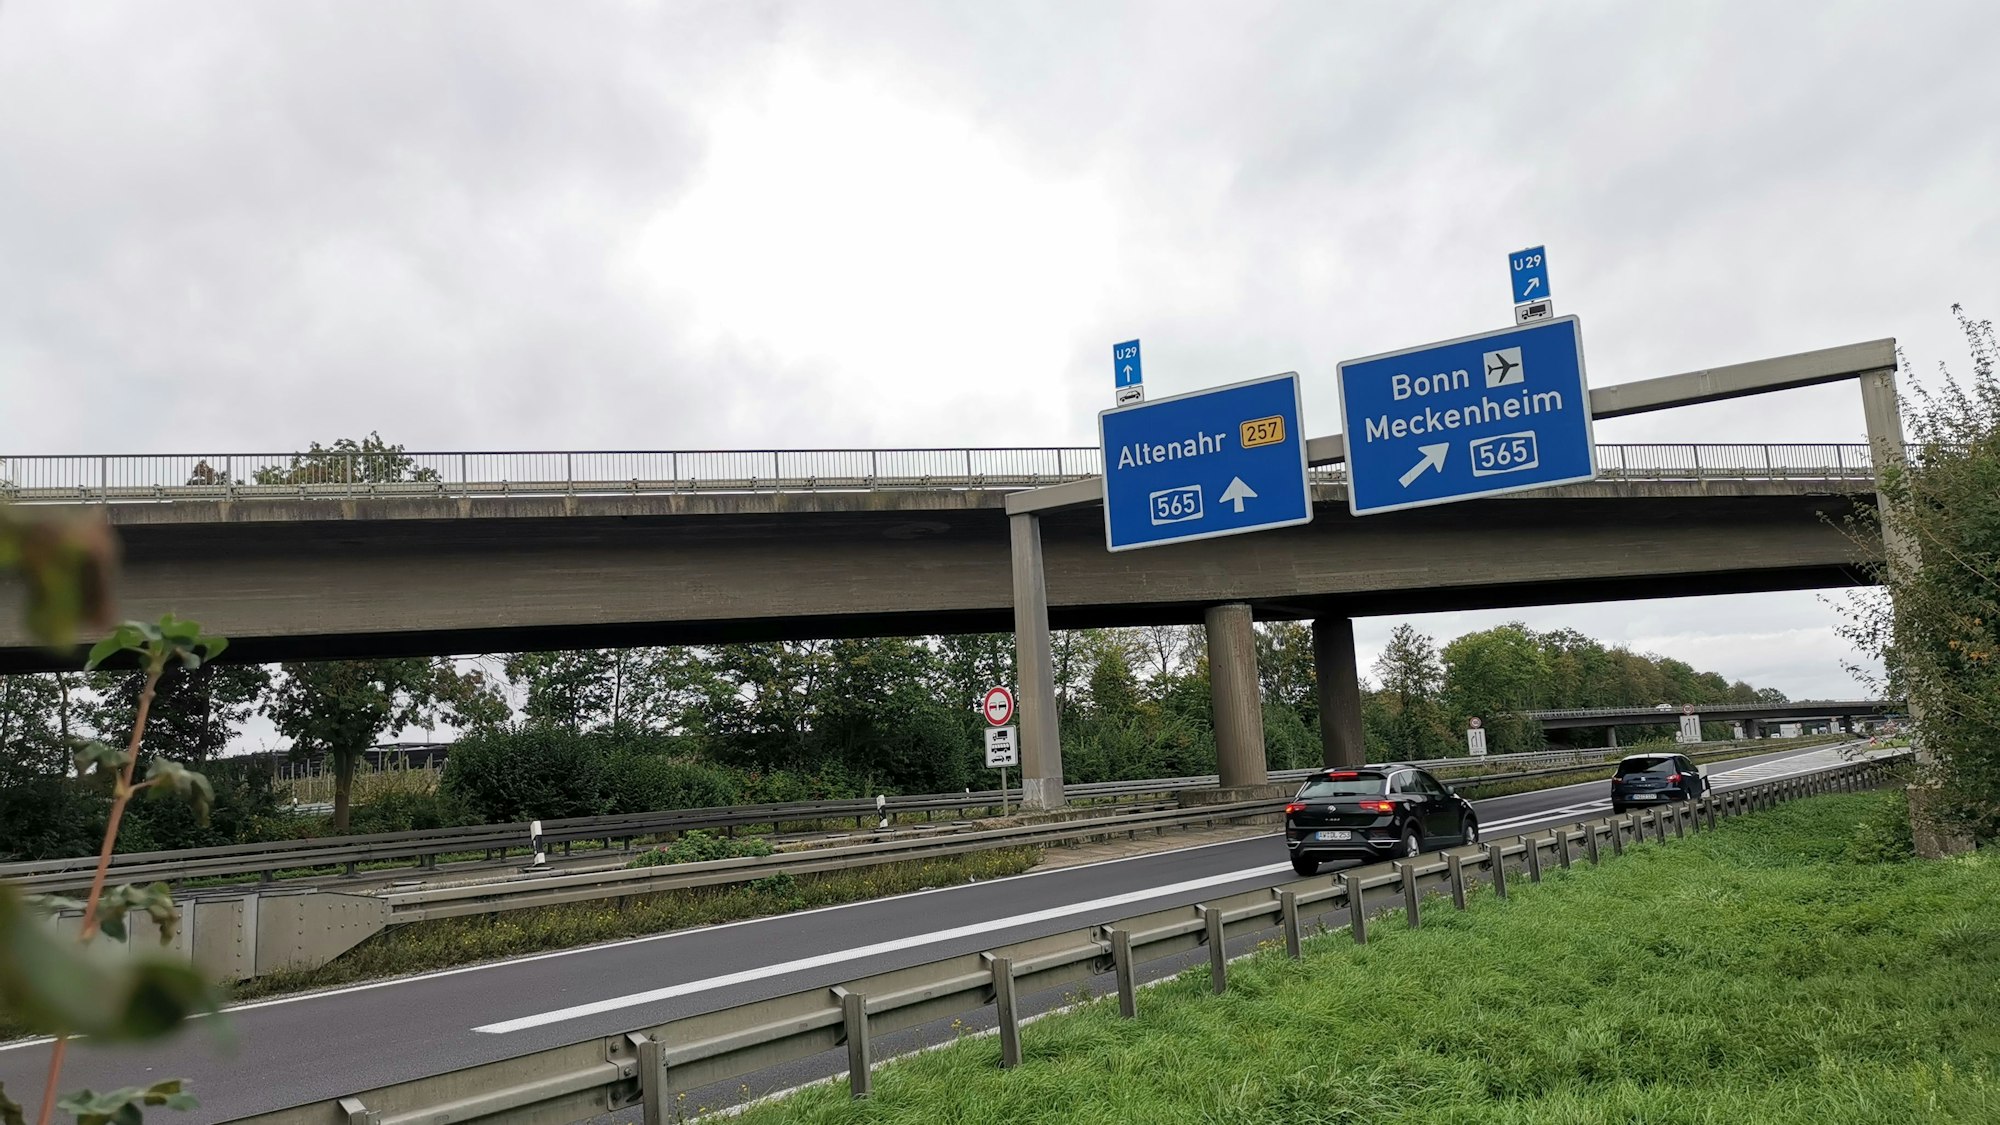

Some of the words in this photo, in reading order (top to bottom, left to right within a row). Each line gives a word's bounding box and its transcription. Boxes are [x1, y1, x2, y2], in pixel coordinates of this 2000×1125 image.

[1391, 369, 1470, 401] Bonn
[1365, 388, 1563, 443] Meckenheim
[1246, 421, 1278, 442] 257
[1117, 431, 1227, 470] Altenahr
[1479, 439, 1528, 468] 565
[1157, 492, 1196, 518] 565
